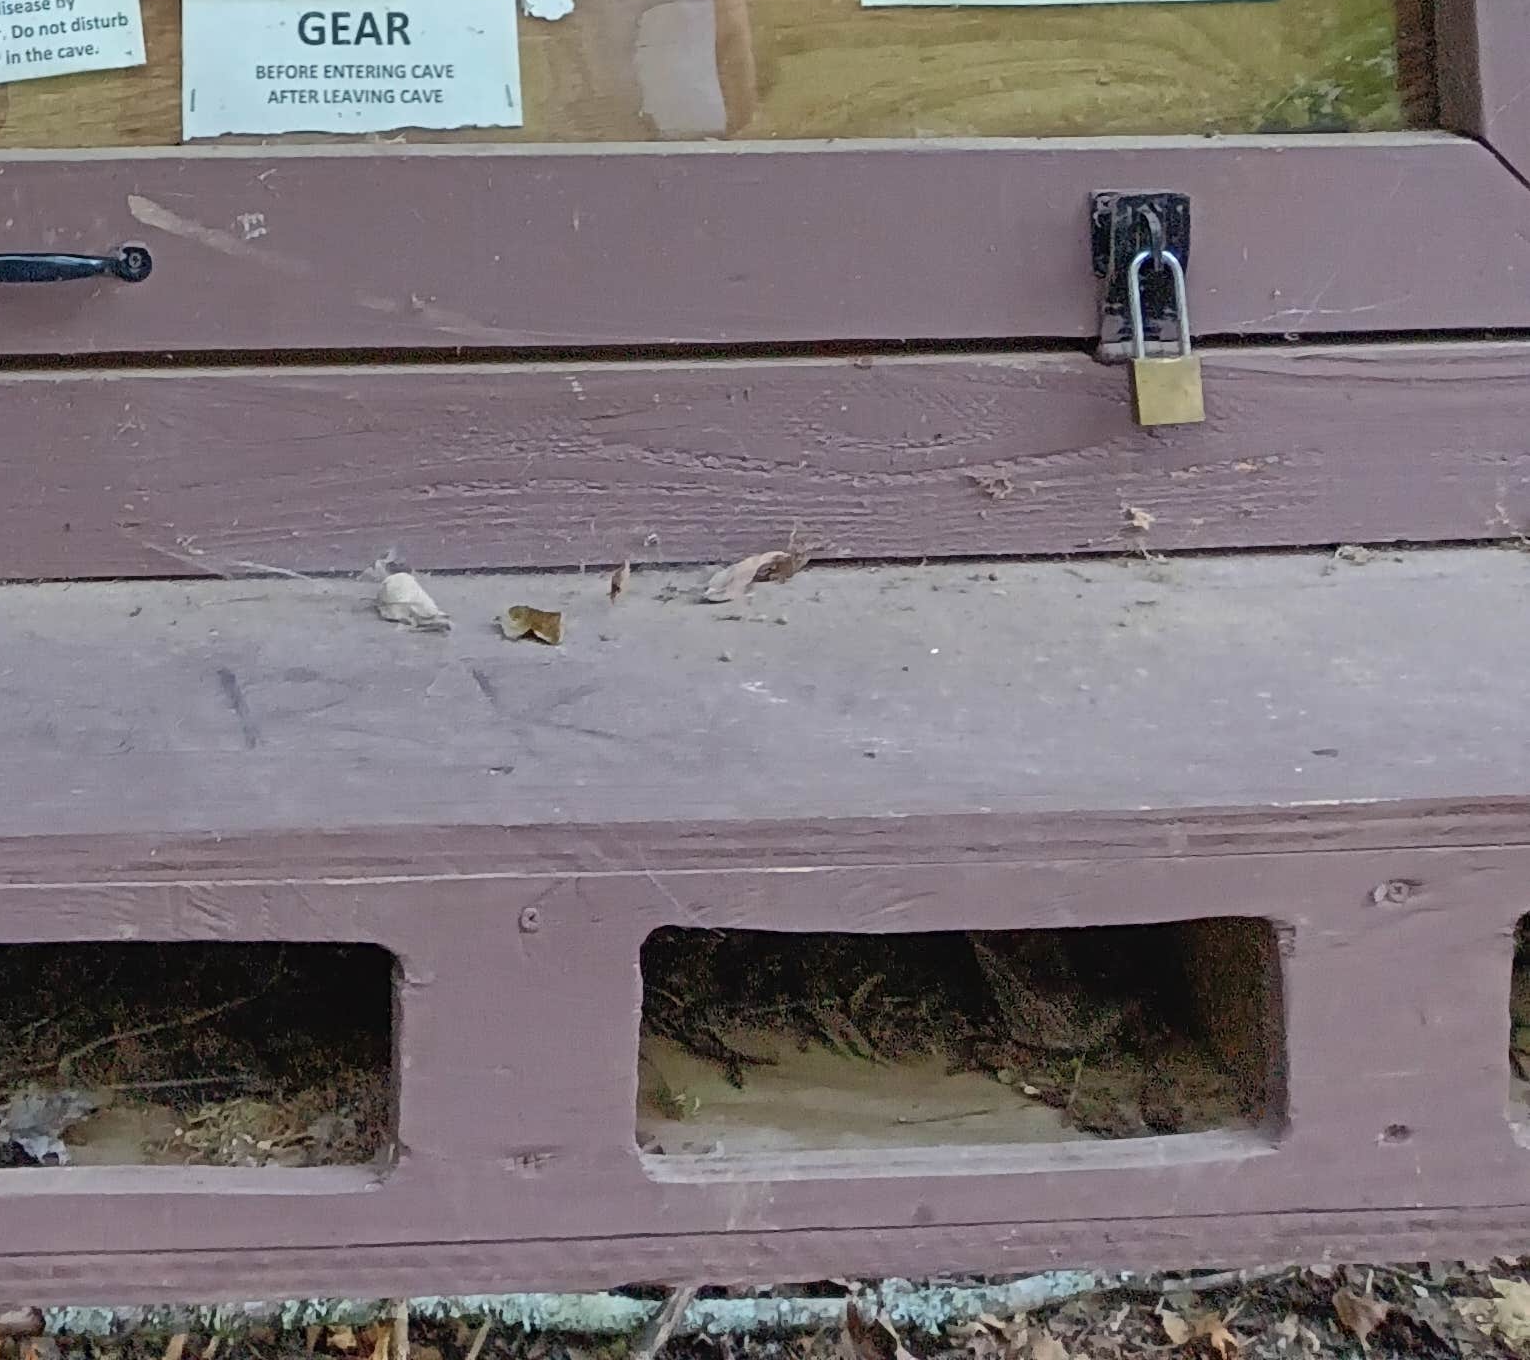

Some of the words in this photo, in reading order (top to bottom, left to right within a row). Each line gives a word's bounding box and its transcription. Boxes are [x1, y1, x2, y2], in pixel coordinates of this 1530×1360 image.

[11, 24, 35, 39] Do
[38, 20, 67, 37] not
[70, 11, 129, 33] disturb
[297, 11, 411, 46] GEAR
[255, 64, 319, 80] BEFORE
[323, 64, 407, 79] ENTERING
[410, 64, 455, 79] CAVE
[267, 89, 320, 105] AFTER
[323, 89, 396, 104] LEAVING
[400, 89, 444, 104] CAVE
